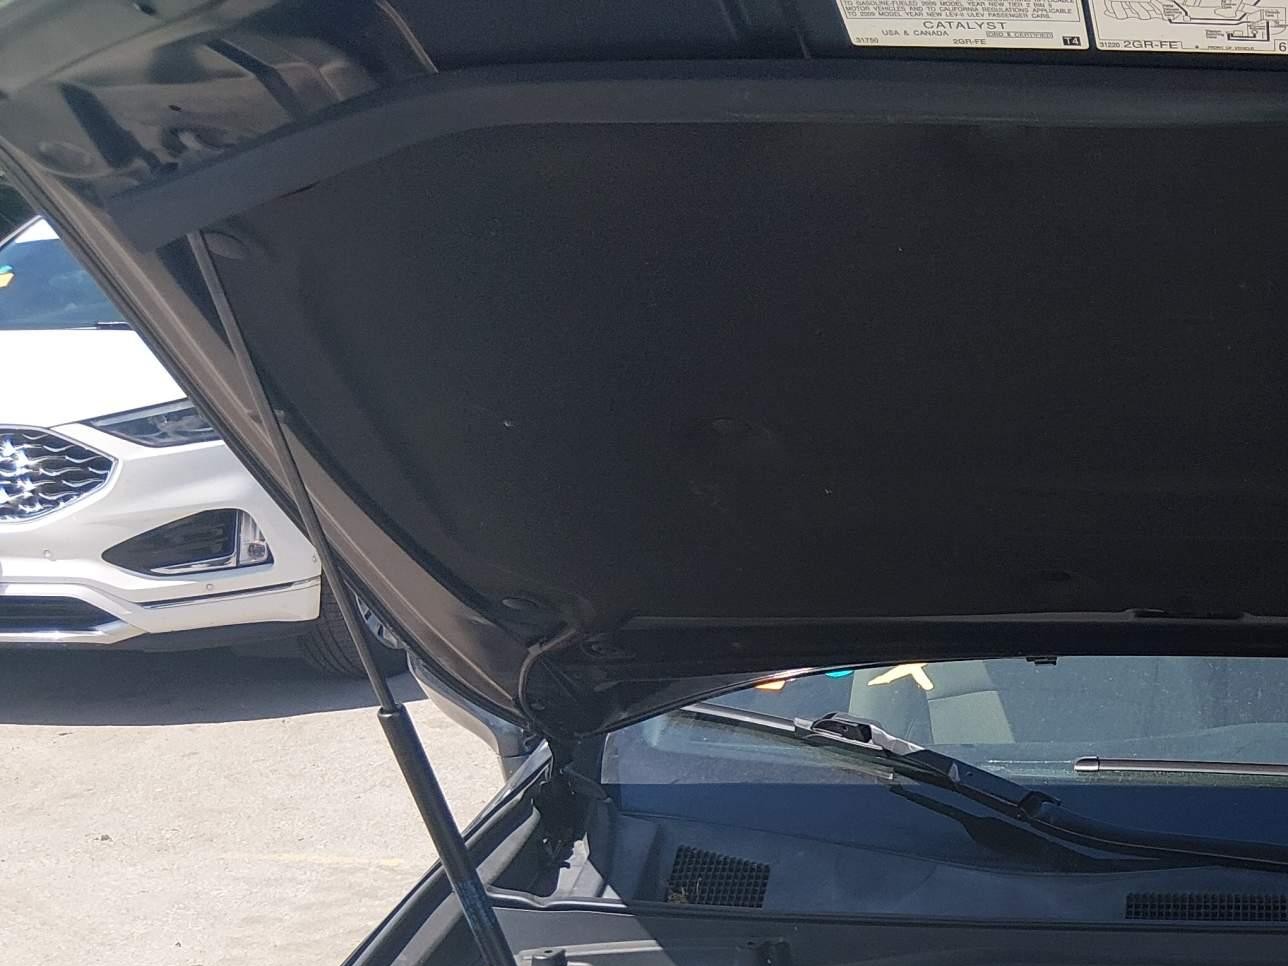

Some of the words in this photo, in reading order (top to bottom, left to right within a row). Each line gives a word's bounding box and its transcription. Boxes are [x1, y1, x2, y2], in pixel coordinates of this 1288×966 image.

[923, 21, 1007, 30] CATALYST
[1063, 37, 1080, 45] T4
[1123, 40, 1179, 49] 2GR-FE
